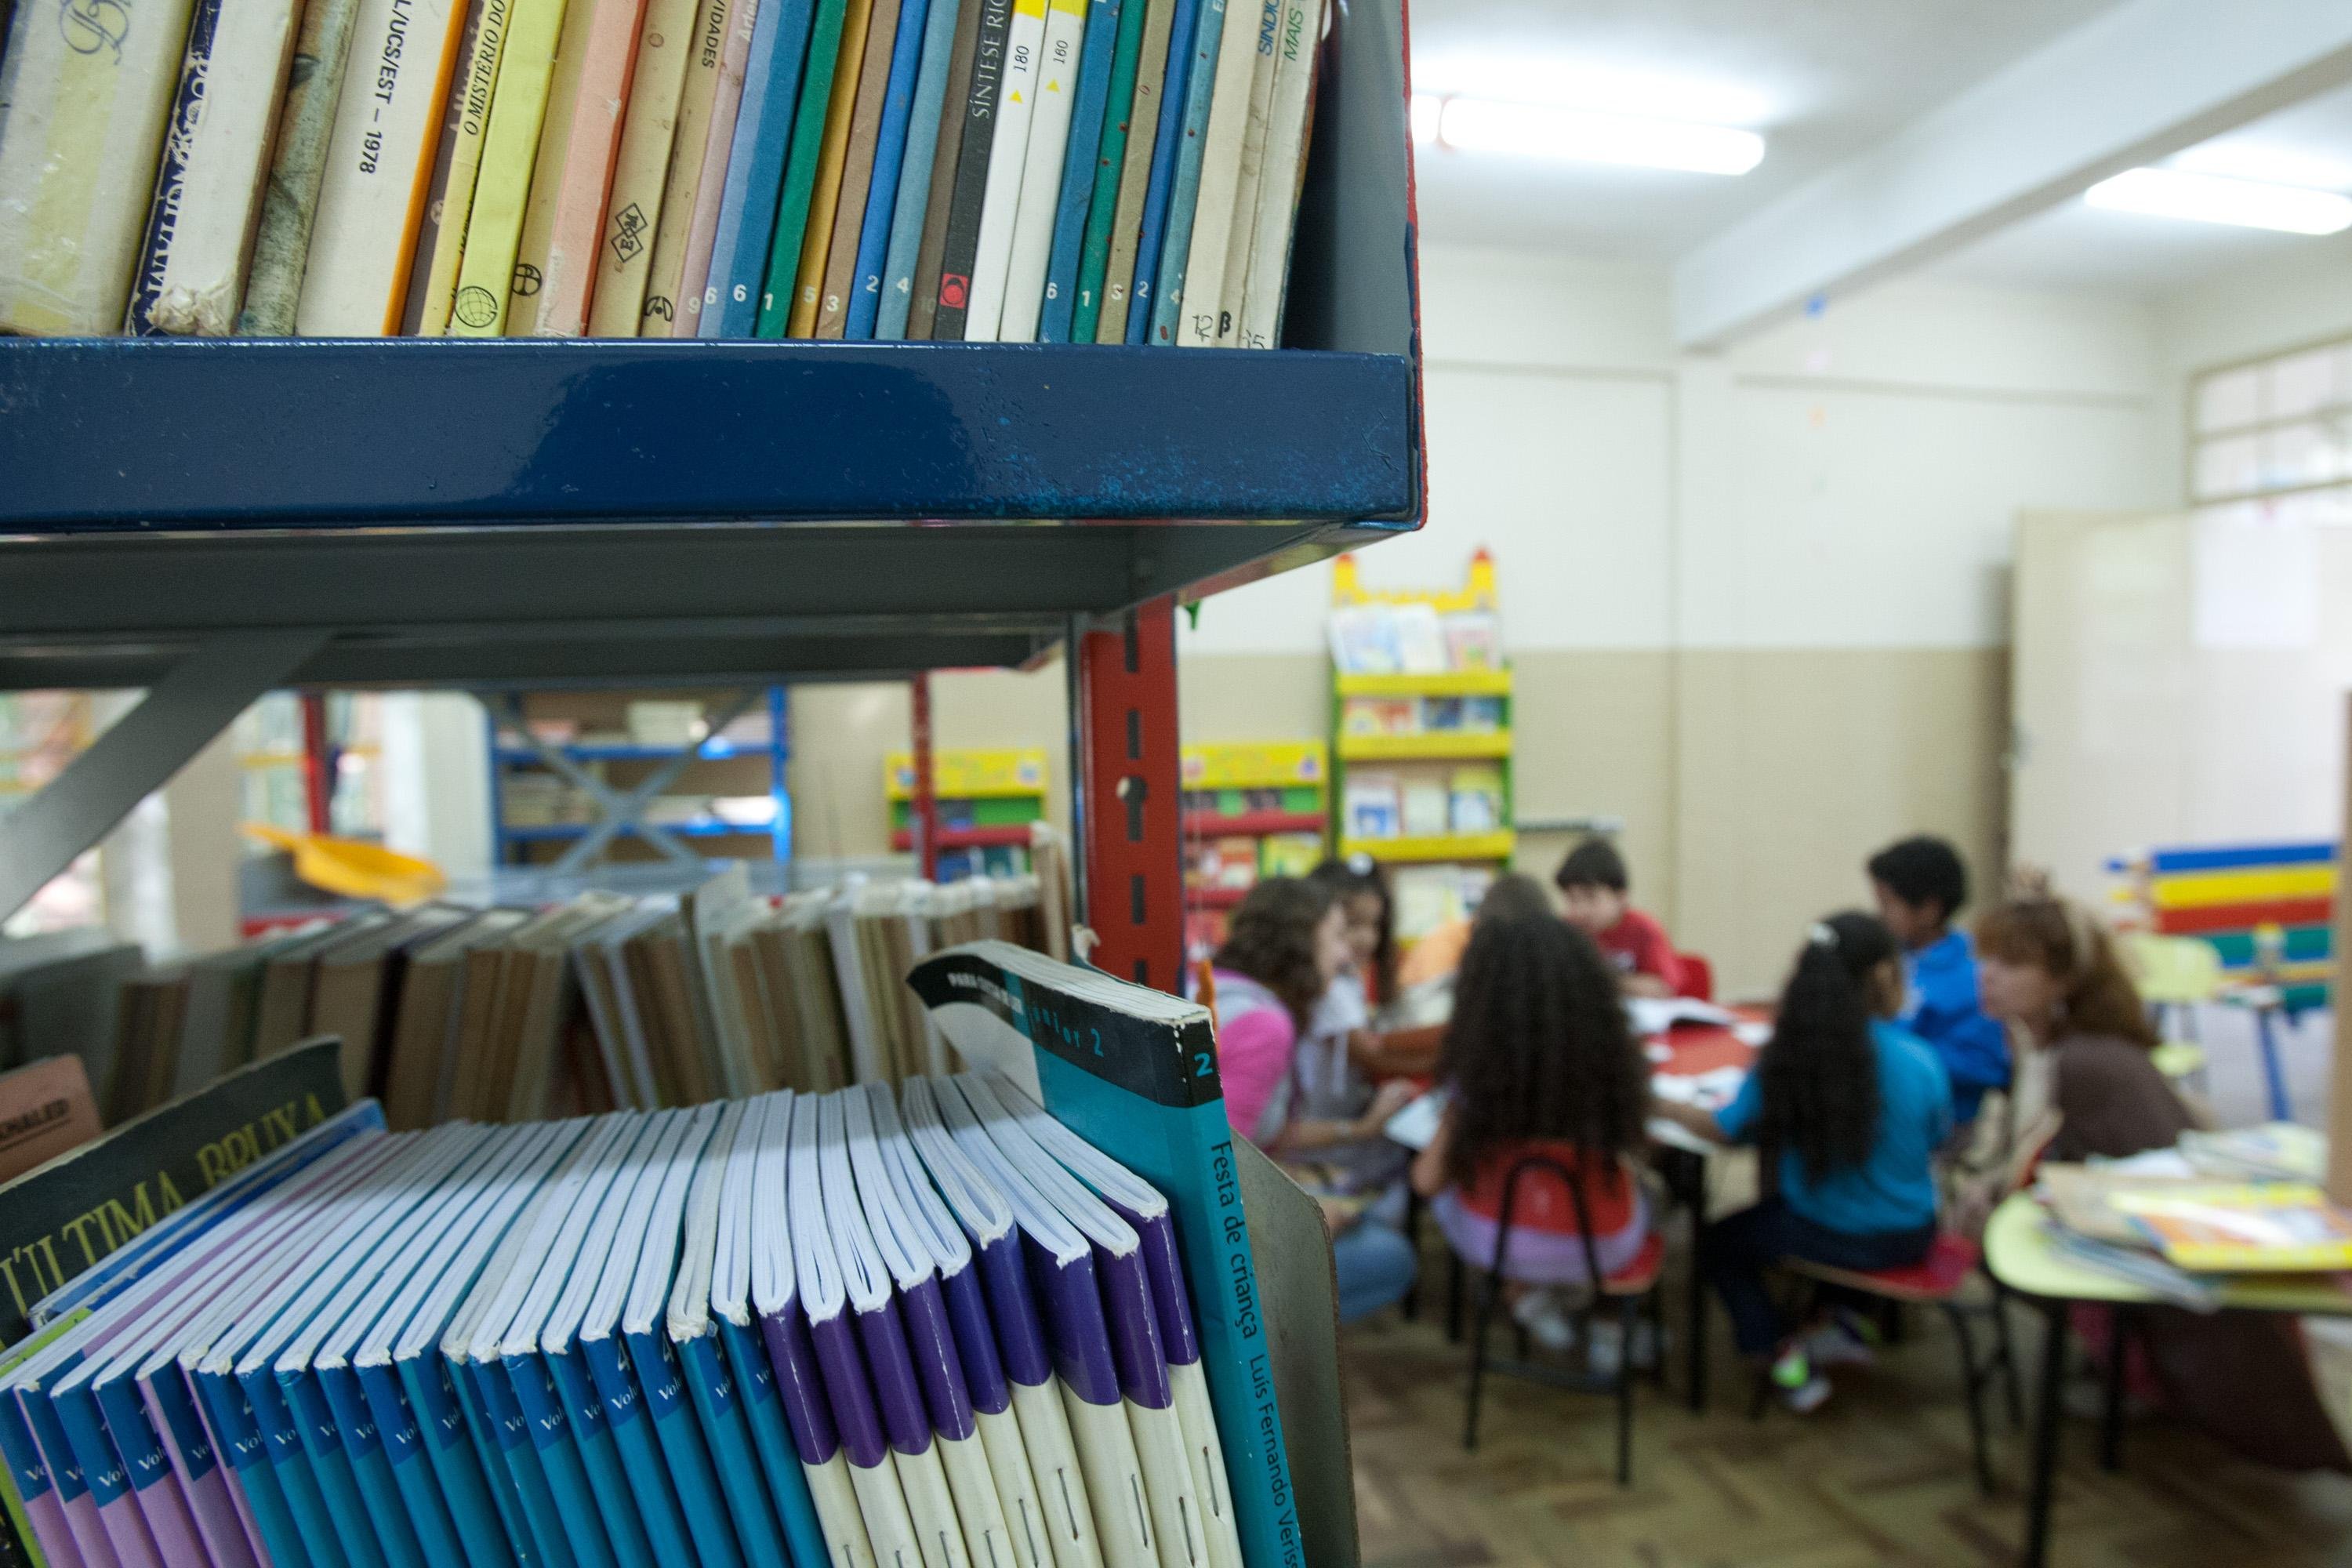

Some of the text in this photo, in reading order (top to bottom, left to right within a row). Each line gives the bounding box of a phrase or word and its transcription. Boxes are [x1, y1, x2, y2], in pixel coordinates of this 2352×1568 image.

[1283, 8, 1305, 61] MAIS
[1013, 45, 1029, 73] 180
[1053, 40, 1069, 65] 160
[467, 29, 499, 119] MISTÉRIO
[969, 38, 1001, 119] SÍNTESE
[463, 121, 478, 136] O
[359, 131, 382, 174] 1978
[706, 287, 717, 304] 6
[733, 285, 746, 302] 6
[803, 286, 815, 303] 5
[866, 276, 877, 292] 2
[1047, 282, 1058, 299] 6
[1138, 281, 1149, 298] 2
[764, 293, 773, 311] 1
[826, 296, 839, 311] 3
[1082, 291, 1090, 307] 1
[1194, 1052, 1213, 1077] 2
[1211, 1140, 1235, 1207] Festa
[1224, 1216, 1245, 1245] de
[1230, 1254, 1258, 1340] criança
[1258, 1402, 1288, 1506] Fernando
